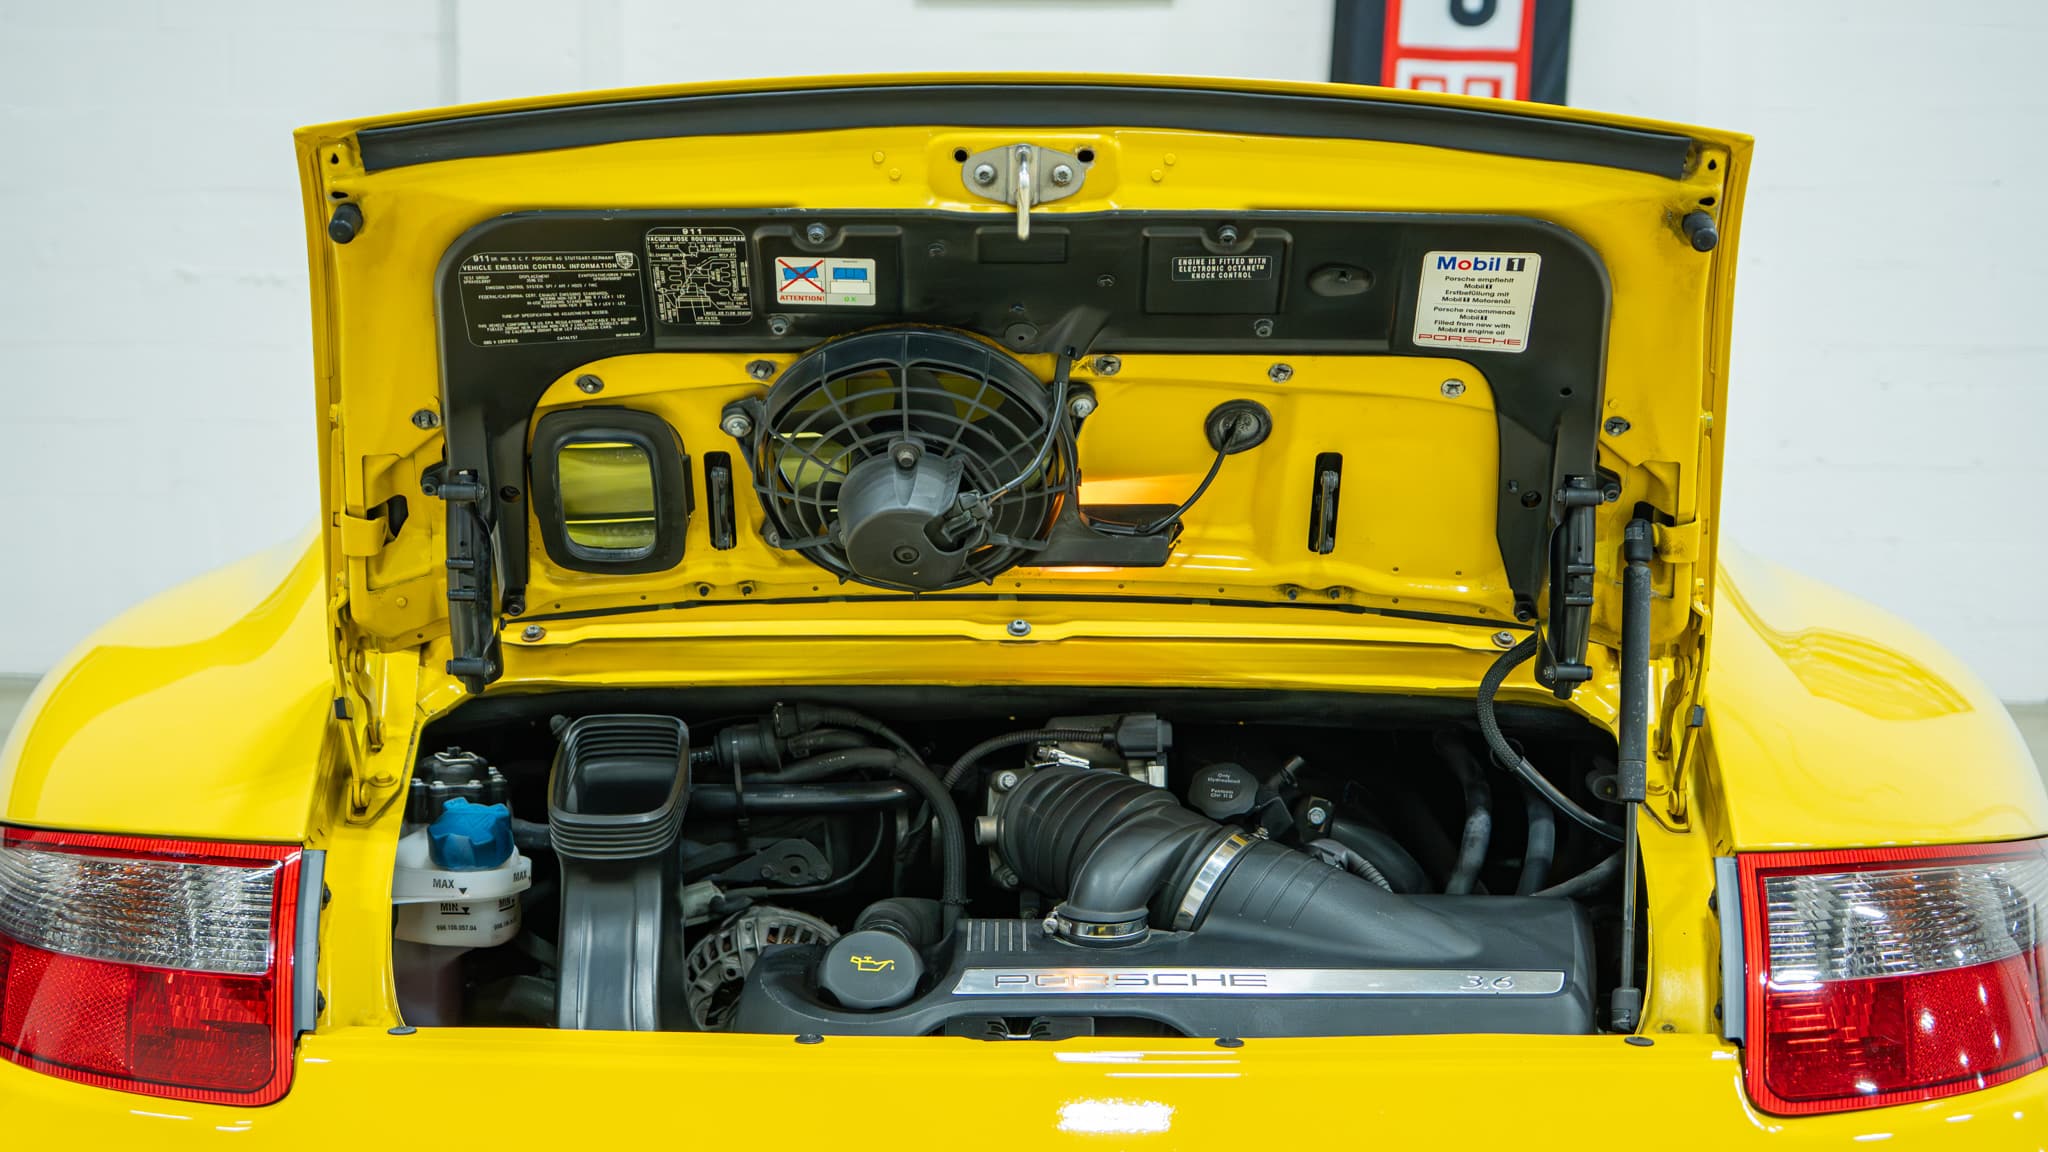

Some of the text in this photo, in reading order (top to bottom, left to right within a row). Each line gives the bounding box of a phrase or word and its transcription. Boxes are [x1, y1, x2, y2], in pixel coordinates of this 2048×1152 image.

[1178, 258, 1205, 266] ENGINE
[1437, 256, 1501, 271] Mobil
[1418, 333, 1521, 346] PORSCHE
[513, 871, 527, 882] MAX
[432, 878, 454, 889] MAX
[440, 902, 458, 911] MIN
[499, 898, 511, 906] MIN
[994, 973, 1514, 990] PORSCHE 3.6
